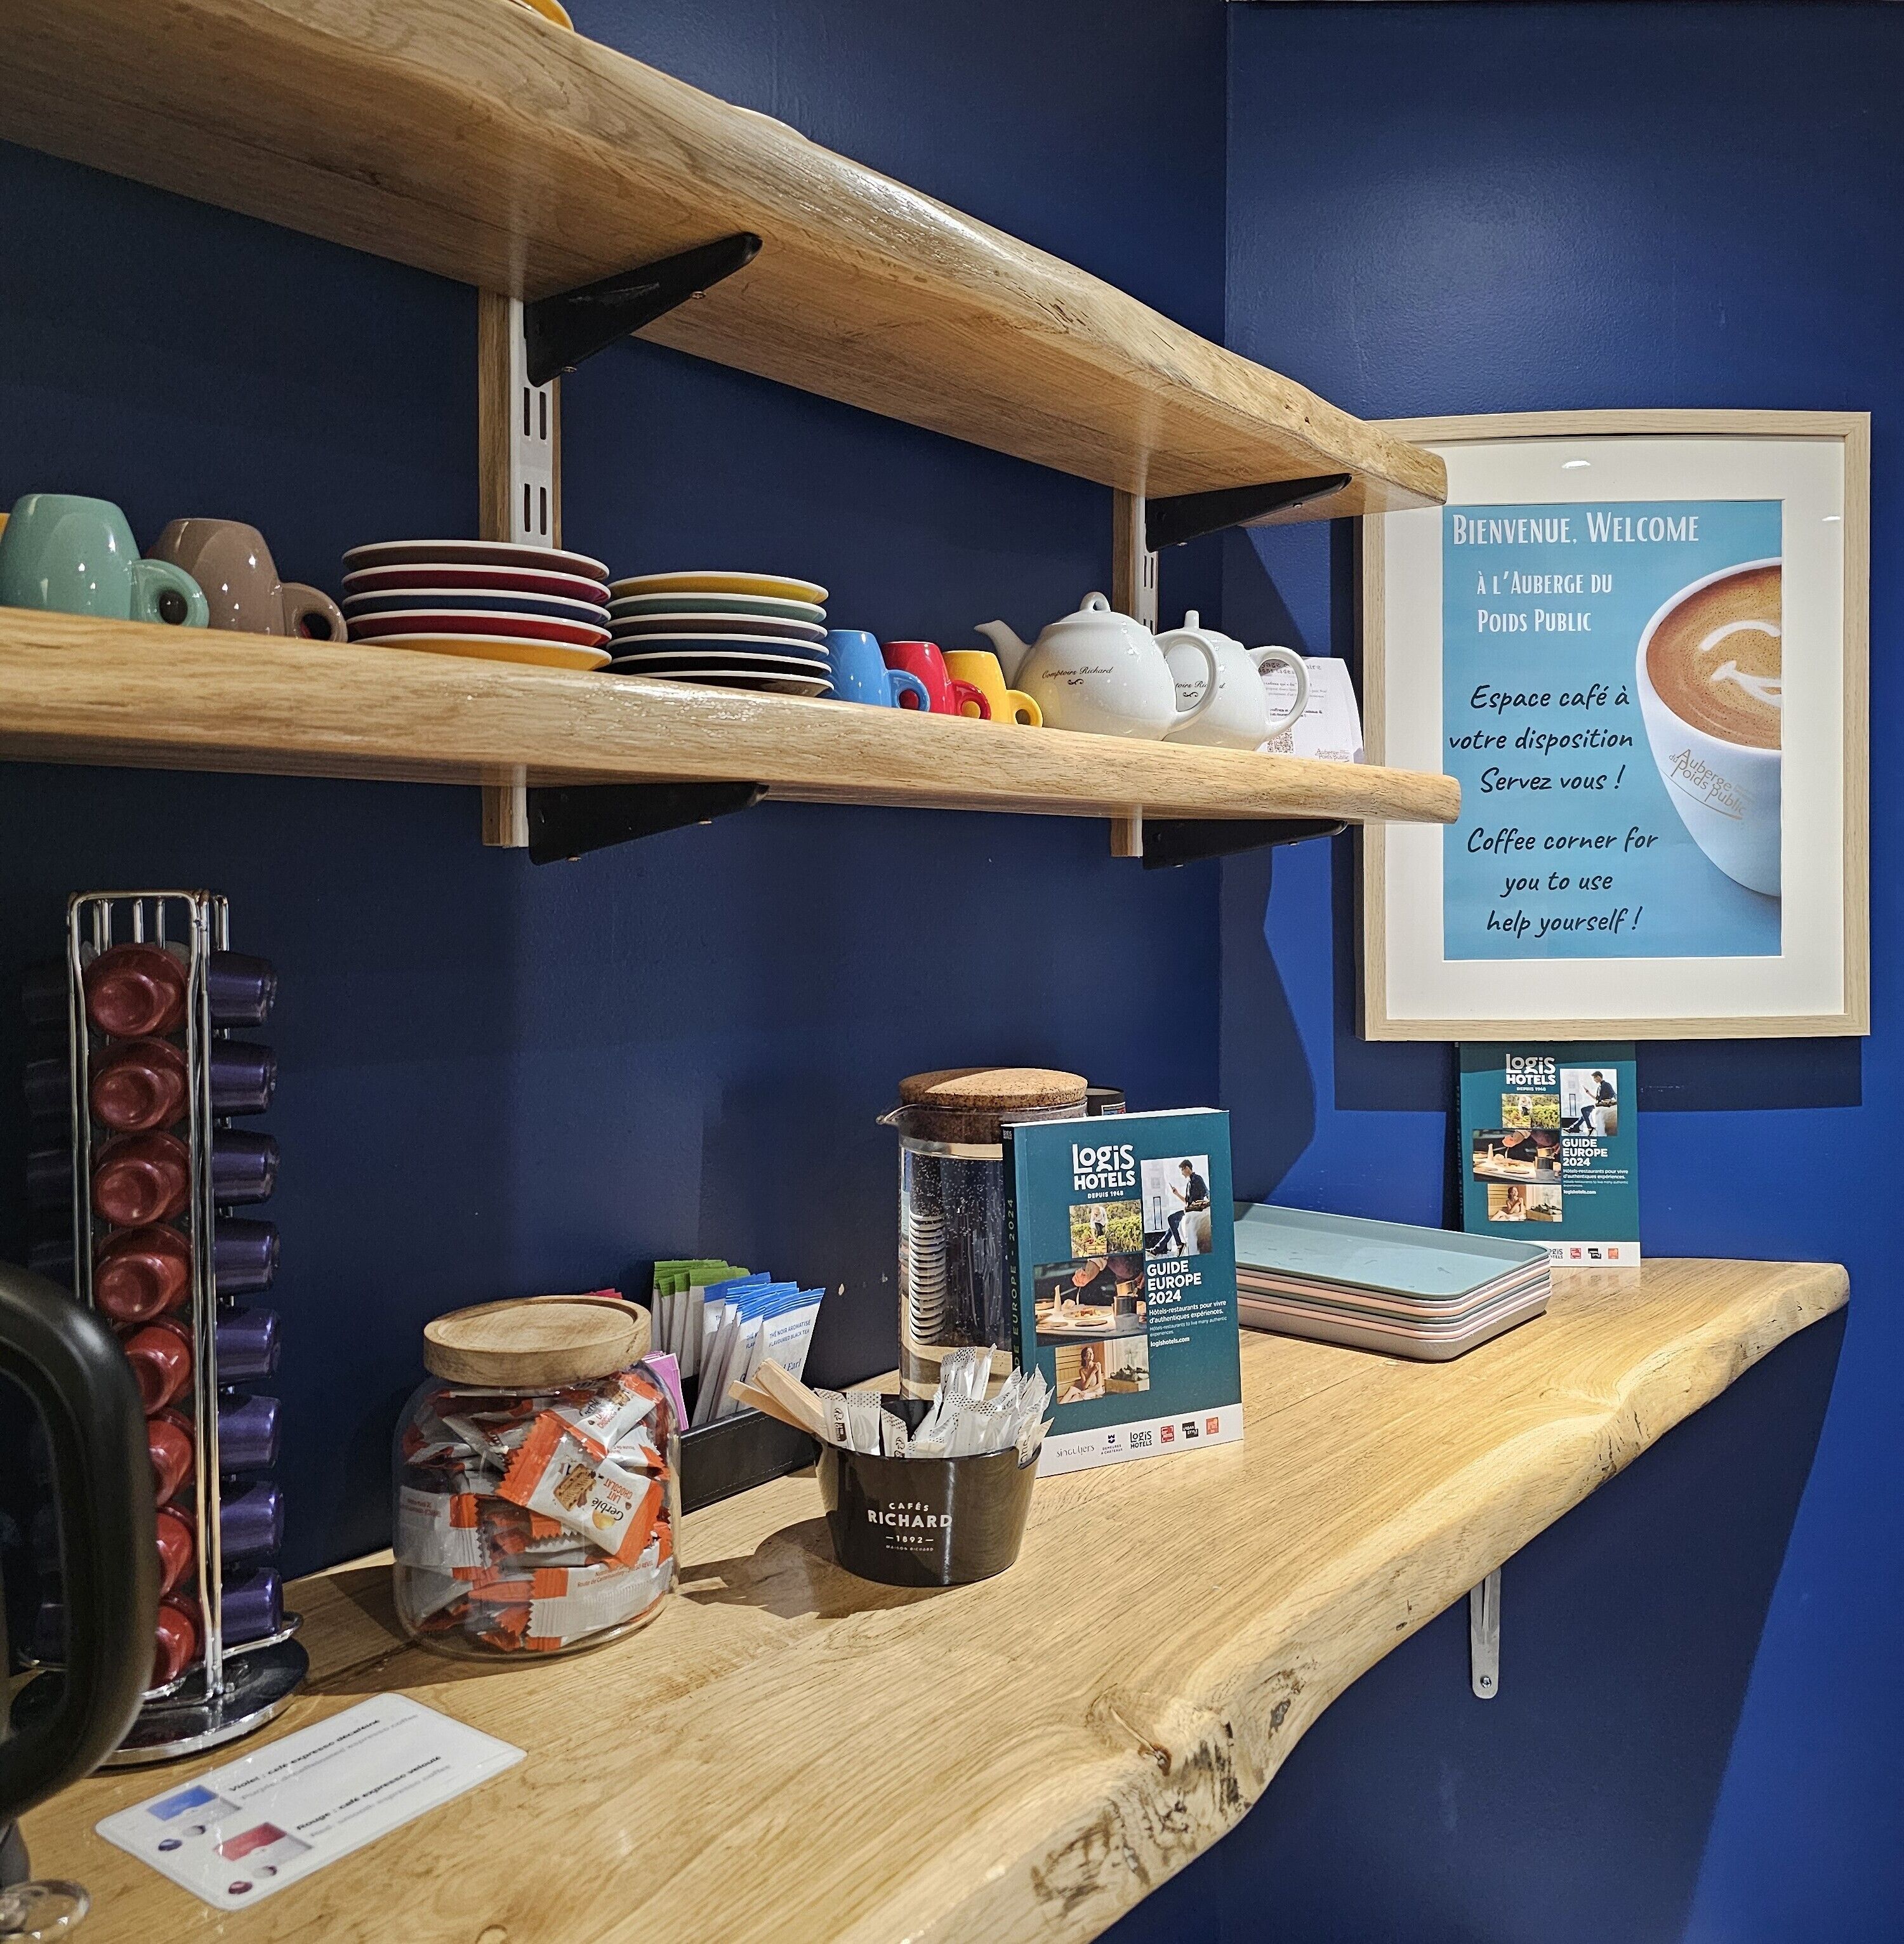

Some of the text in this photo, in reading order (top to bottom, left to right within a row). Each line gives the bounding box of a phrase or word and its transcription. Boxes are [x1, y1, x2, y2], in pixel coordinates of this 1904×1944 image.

[1041, 666, 1114, 679] Comptoirs Richard
[1470, 683, 1630, 715] Espace café à
[1449, 726, 1634, 755] votre disposition
[1480, 764, 1626, 793] Servez vous !
[1677, 748, 1732, 792] Auberge
[1467, 826, 1659, 854] Coffee corner for
[1500, 871, 1613, 898] you to use
[1486, 906, 1643, 939] help yourself !
[1505, 1074, 1556, 1085] HOTELS
[1562, 1138, 1597, 1147] GUIDE
[1563, 1147, 1608, 1157] EUROPE
[1563, 1157, 1591, 1167] 2024
[1074, 1170, 1135, 1191] HOTELS
[1007, 1199, 1015, 1241] 2024
[1147, 1260, 1189, 1277] GUIDE
[1147, 1272, 1202, 1292] EUROPE
[1008, 1264, 1019, 1336] EUROPE
[1148, 1289, 1182, 1306] 2024
[1199, 1302, 1213, 1310] pour
[1149, 1313, 1190, 1324] d'authentiques
[777, 1326, 788, 1336] NOIR
[788, 1319, 811, 1332] AROMATISÉ
[769, 1335, 791, 1348] FLAVOURED
[1150, 1337, 1190, 1347] logishotels.com
[787, 1358, 802, 1372] Earl
[1130, 1439, 1153, 1450] HOTELS
[603, 1478, 633, 1500] CHOCOLAT
[607, 1491, 621, 1504] LAIT
[591, 1497, 624, 1521] Gerblé
[889, 1502, 929, 1512] CAFÉS
[868, 1509, 953, 1528] RICHARD
[896, 1535, 923, 1544] 1892
